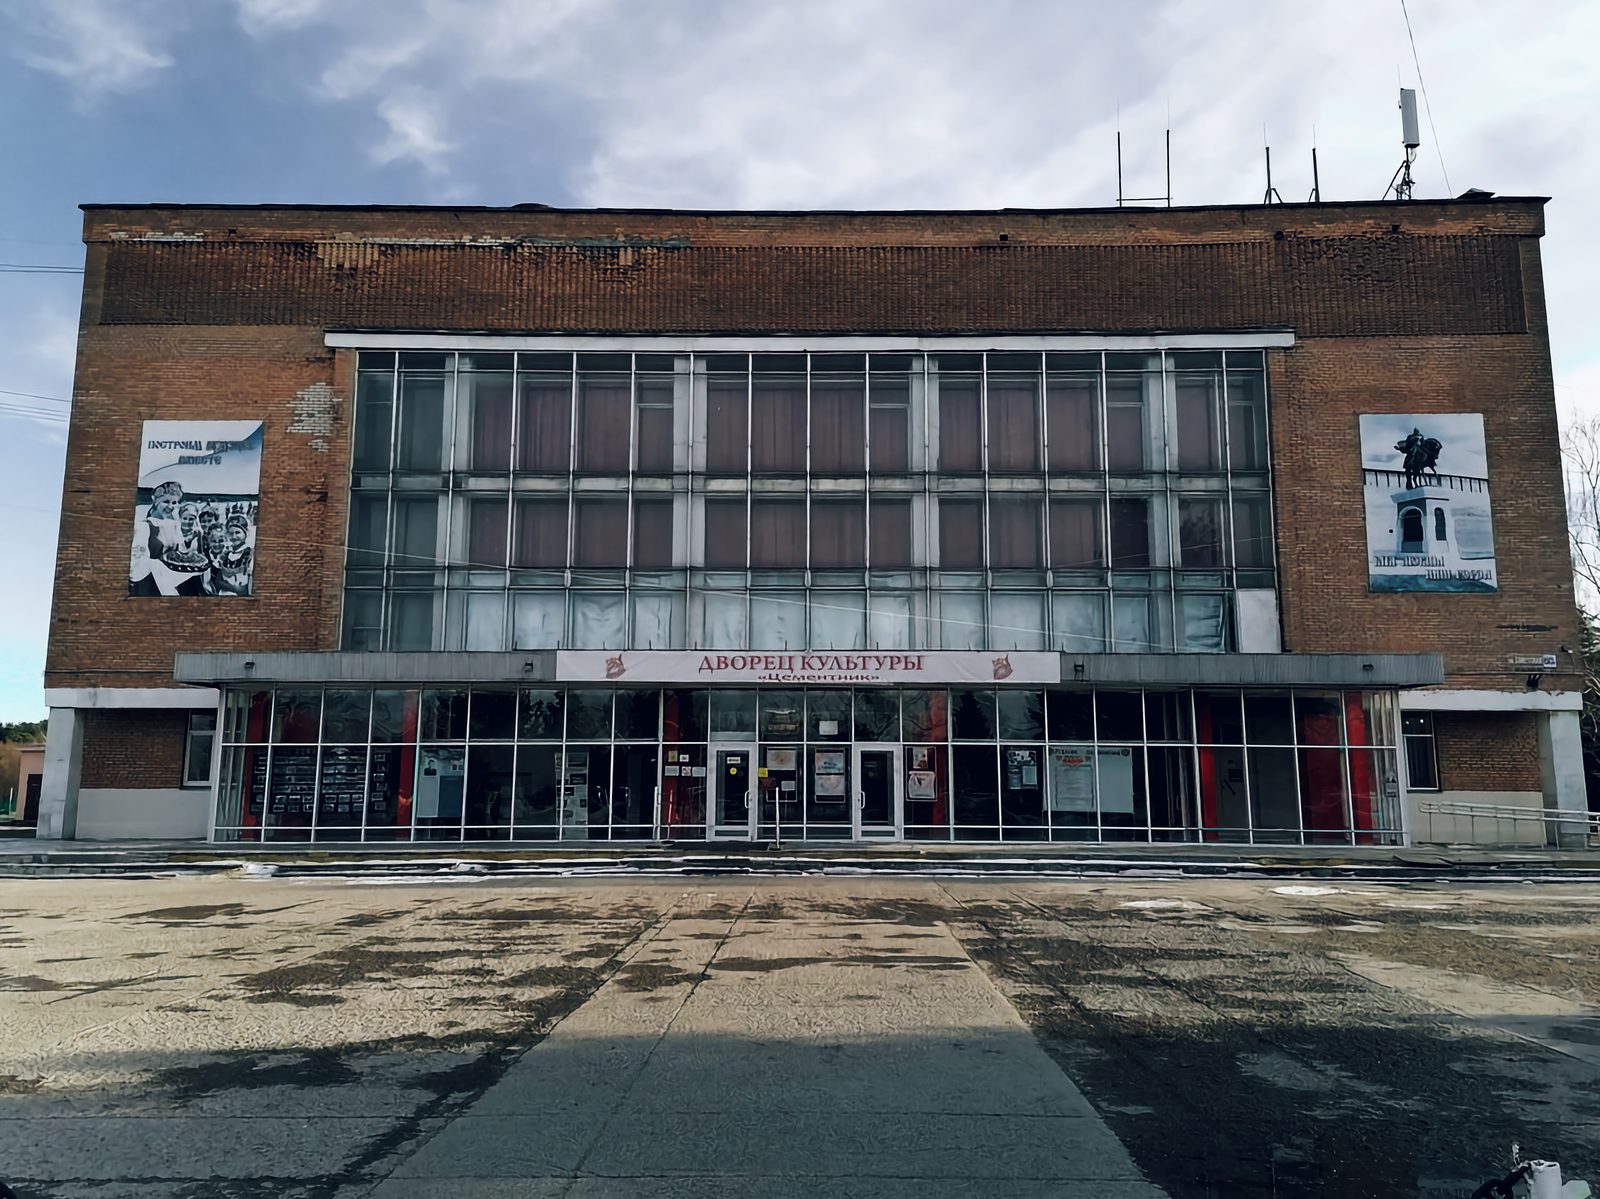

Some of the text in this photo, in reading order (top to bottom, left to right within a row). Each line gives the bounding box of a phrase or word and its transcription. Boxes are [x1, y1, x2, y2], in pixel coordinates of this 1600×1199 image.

[699, 655, 924, 674] ДВОРЕЦ КУЛЬТУРЫ
[757, 673, 880, 682] «Цементник»
